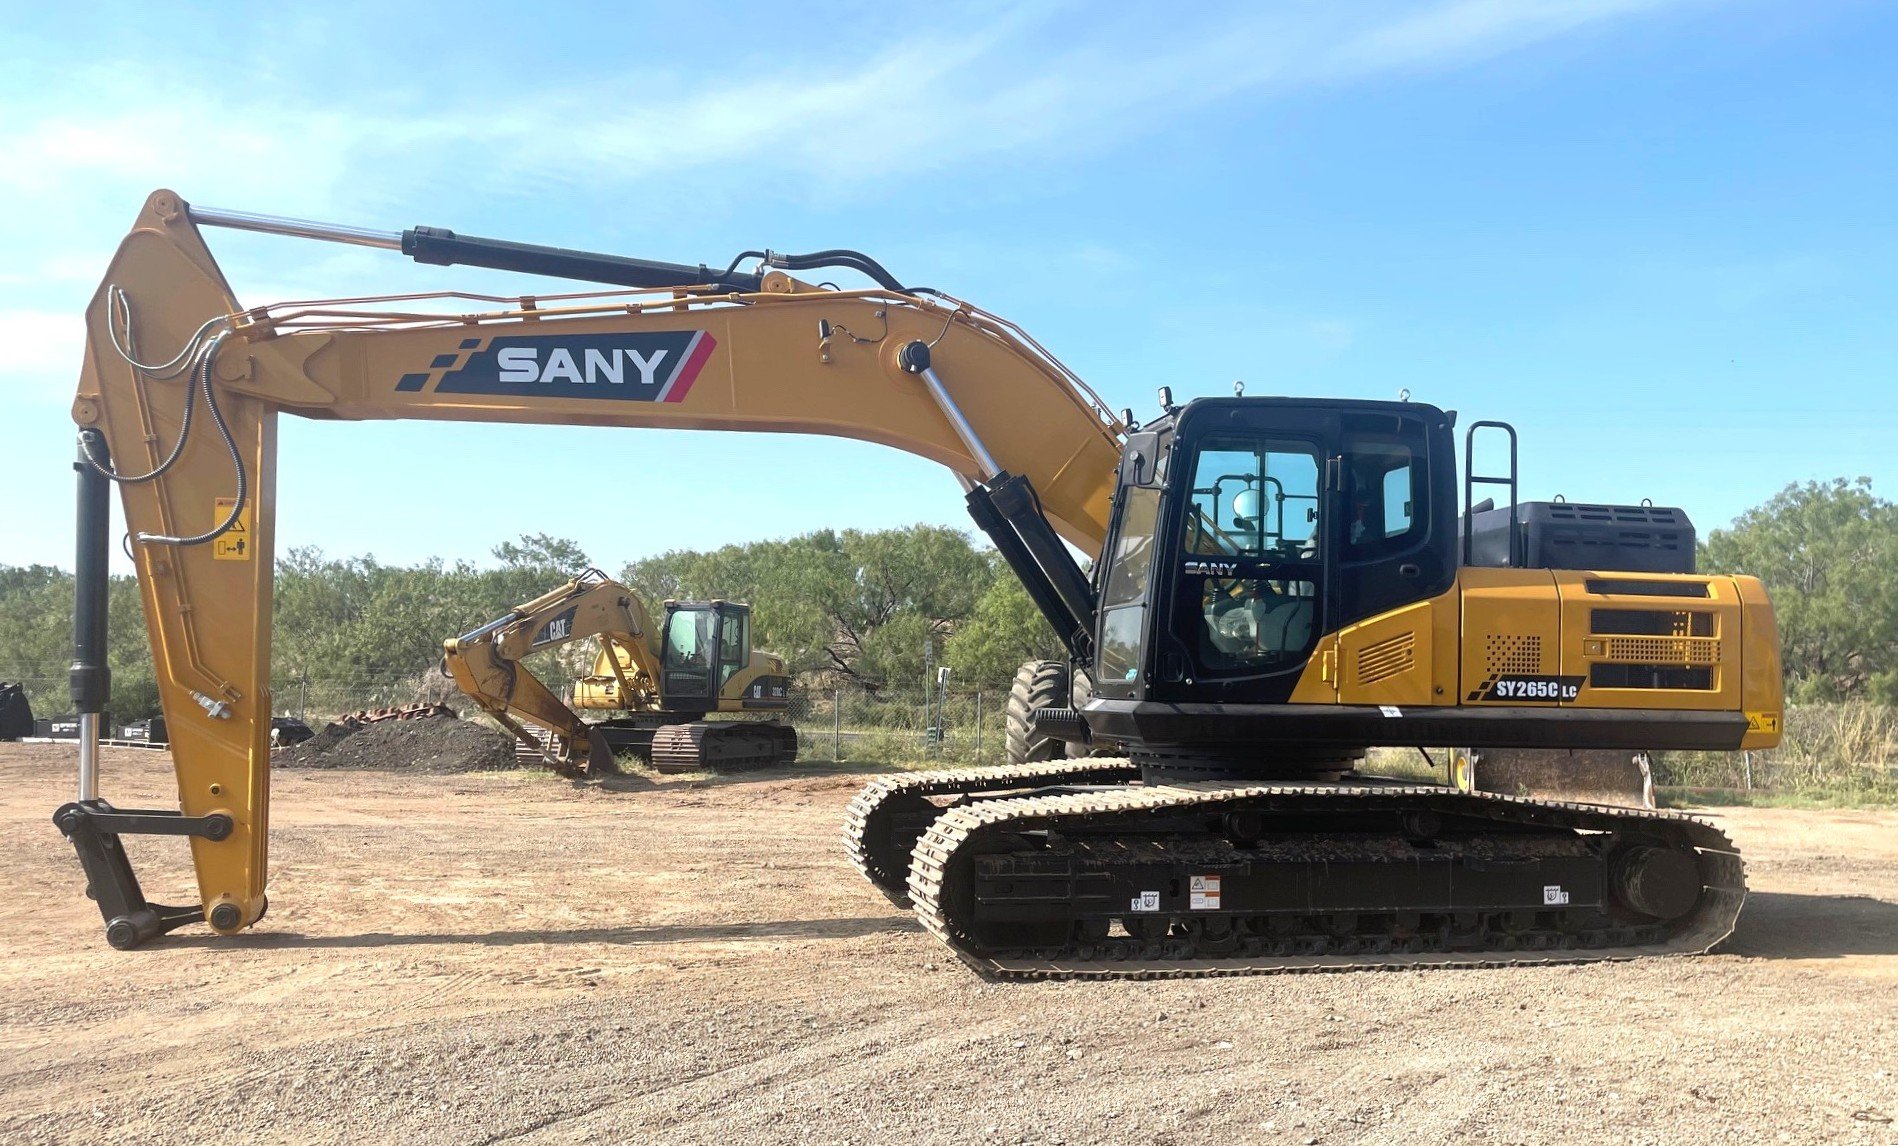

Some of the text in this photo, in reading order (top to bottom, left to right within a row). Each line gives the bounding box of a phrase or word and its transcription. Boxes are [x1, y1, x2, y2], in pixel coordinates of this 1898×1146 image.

[497, 347, 669, 384] SANY
[1185, 561, 1237, 576] SANY
[550, 618, 566, 640] CAT
[753, 685, 762, 699] CAT
[1496, 681, 1577, 698] SY265C LC
